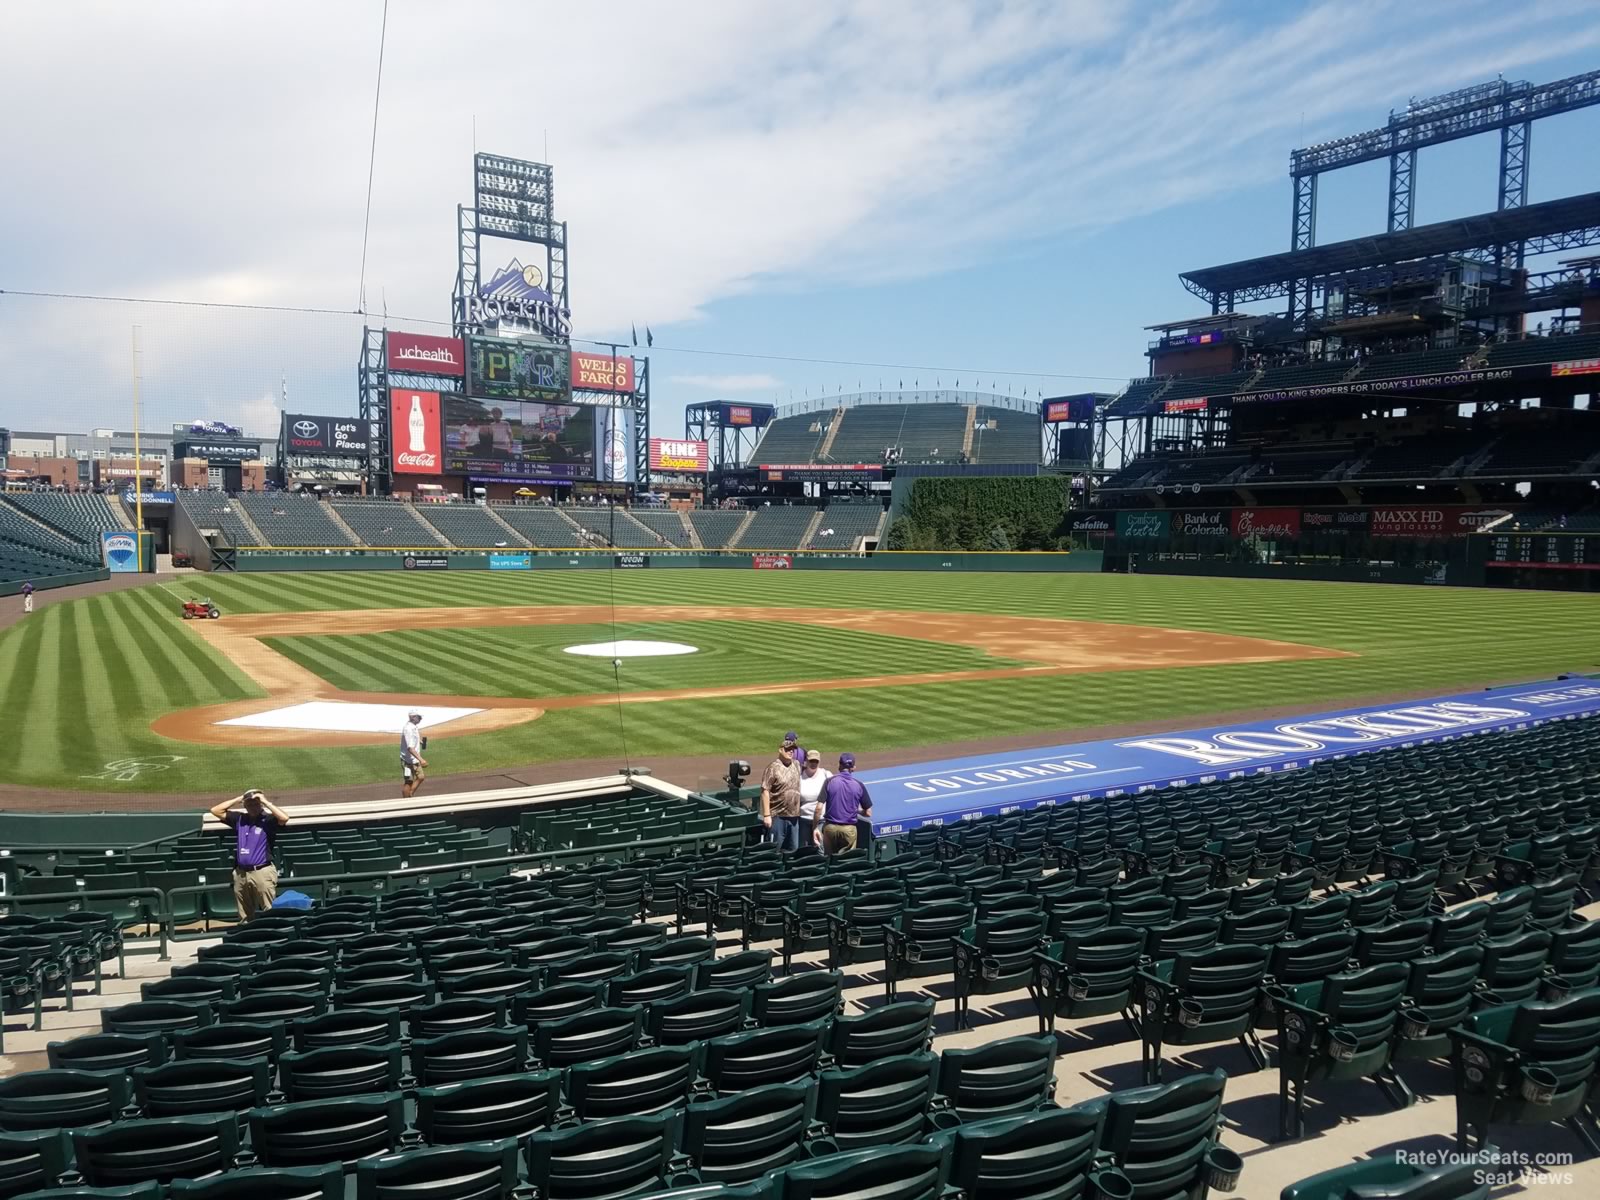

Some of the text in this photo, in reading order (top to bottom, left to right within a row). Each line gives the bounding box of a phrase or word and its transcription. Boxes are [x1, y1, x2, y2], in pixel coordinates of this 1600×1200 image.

[453, 295, 573, 336] ROCKIES
[1169, 338, 1186, 347] THANK
[400, 344, 454, 363] uchealth
[578, 358, 626, 374] WELLS
[1232, 370, 1512, 404] THANK YOU TO KING SOOPERS FOR TODAY'S LUNCH COOLER BAG!
[731, 408, 750, 416] KING
[1049, 404, 1068, 414] KING
[202, 426, 228, 434] TOYOTA
[334, 422, 357, 432] Let's
[334, 431, 349, 440] Go
[290, 438, 323, 448] TOYOTA
[336, 440, 366, 450] Places
[190, 446, 258, 456] TUNDRA
[660, 442, 698, 457] KING
[660, 454, 698, 471] Soopers
[1184, 512, 1222, 524] Bank of
[1304, 512, 1368, 526] Exxon Mobil
[1373, 510, 1444, 523] MAXX HD
[1072, 520, 1109, 530] Safelite
[1184, 524, 1228, 536] Colorado
[1372, 523, 1444, 532] sunglasses
[1114, 701, 1531, 766] ROCKIES
[903, 760, 1098, 793] COLORADO
